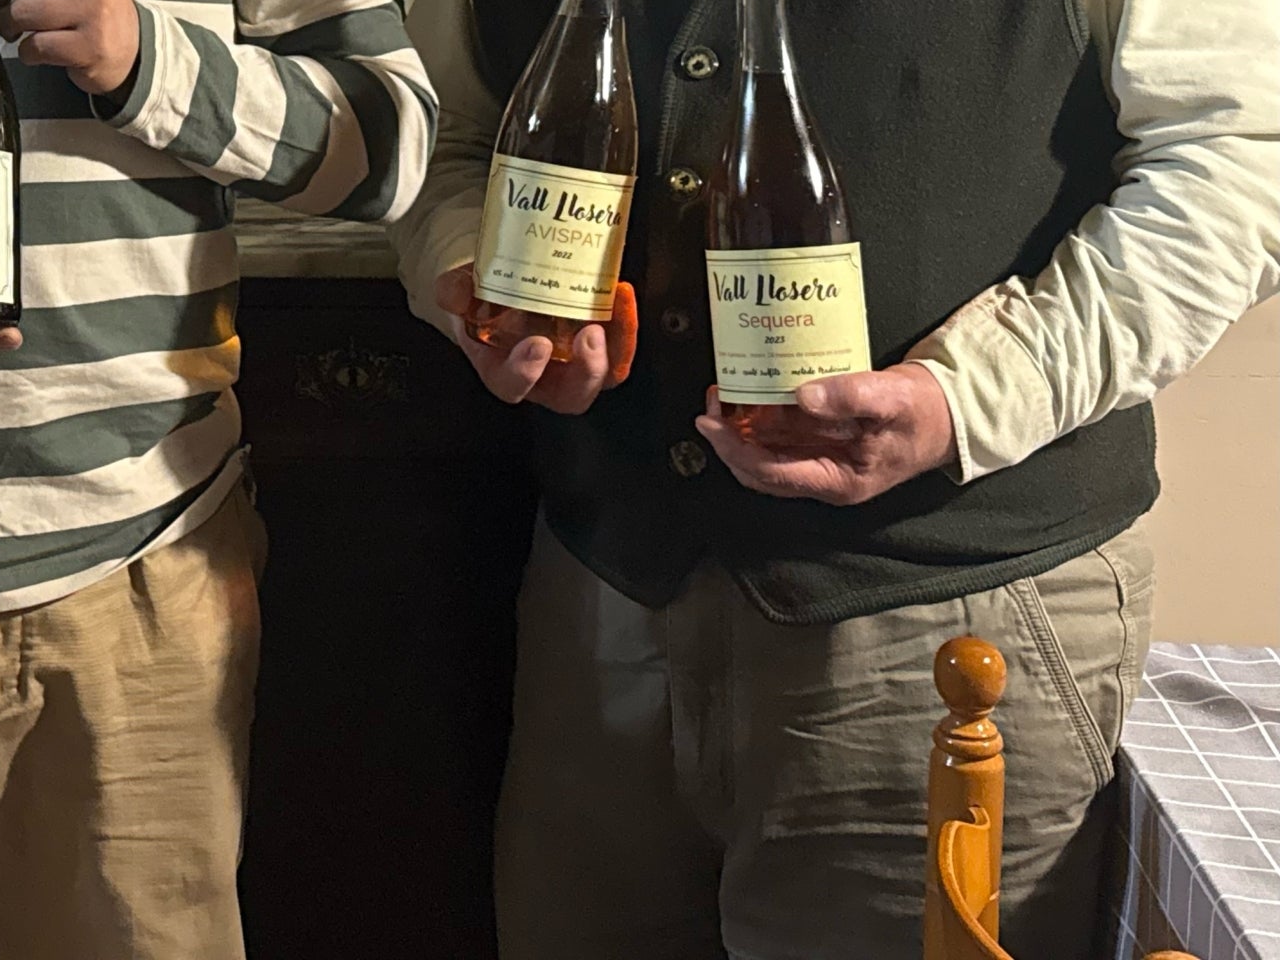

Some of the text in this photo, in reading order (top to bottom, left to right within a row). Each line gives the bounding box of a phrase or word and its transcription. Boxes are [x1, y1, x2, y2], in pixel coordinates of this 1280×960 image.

[508, 178, 621, 226] Vall Llosera
[524, 223, 604, 249] AVISPAT
[551, 249, 573, 260] 2022
[713, 271, 839, 306] Vall Llosera
[738, 312, 815, 331] Sequera
[764, 335, 786, 344] 2023
